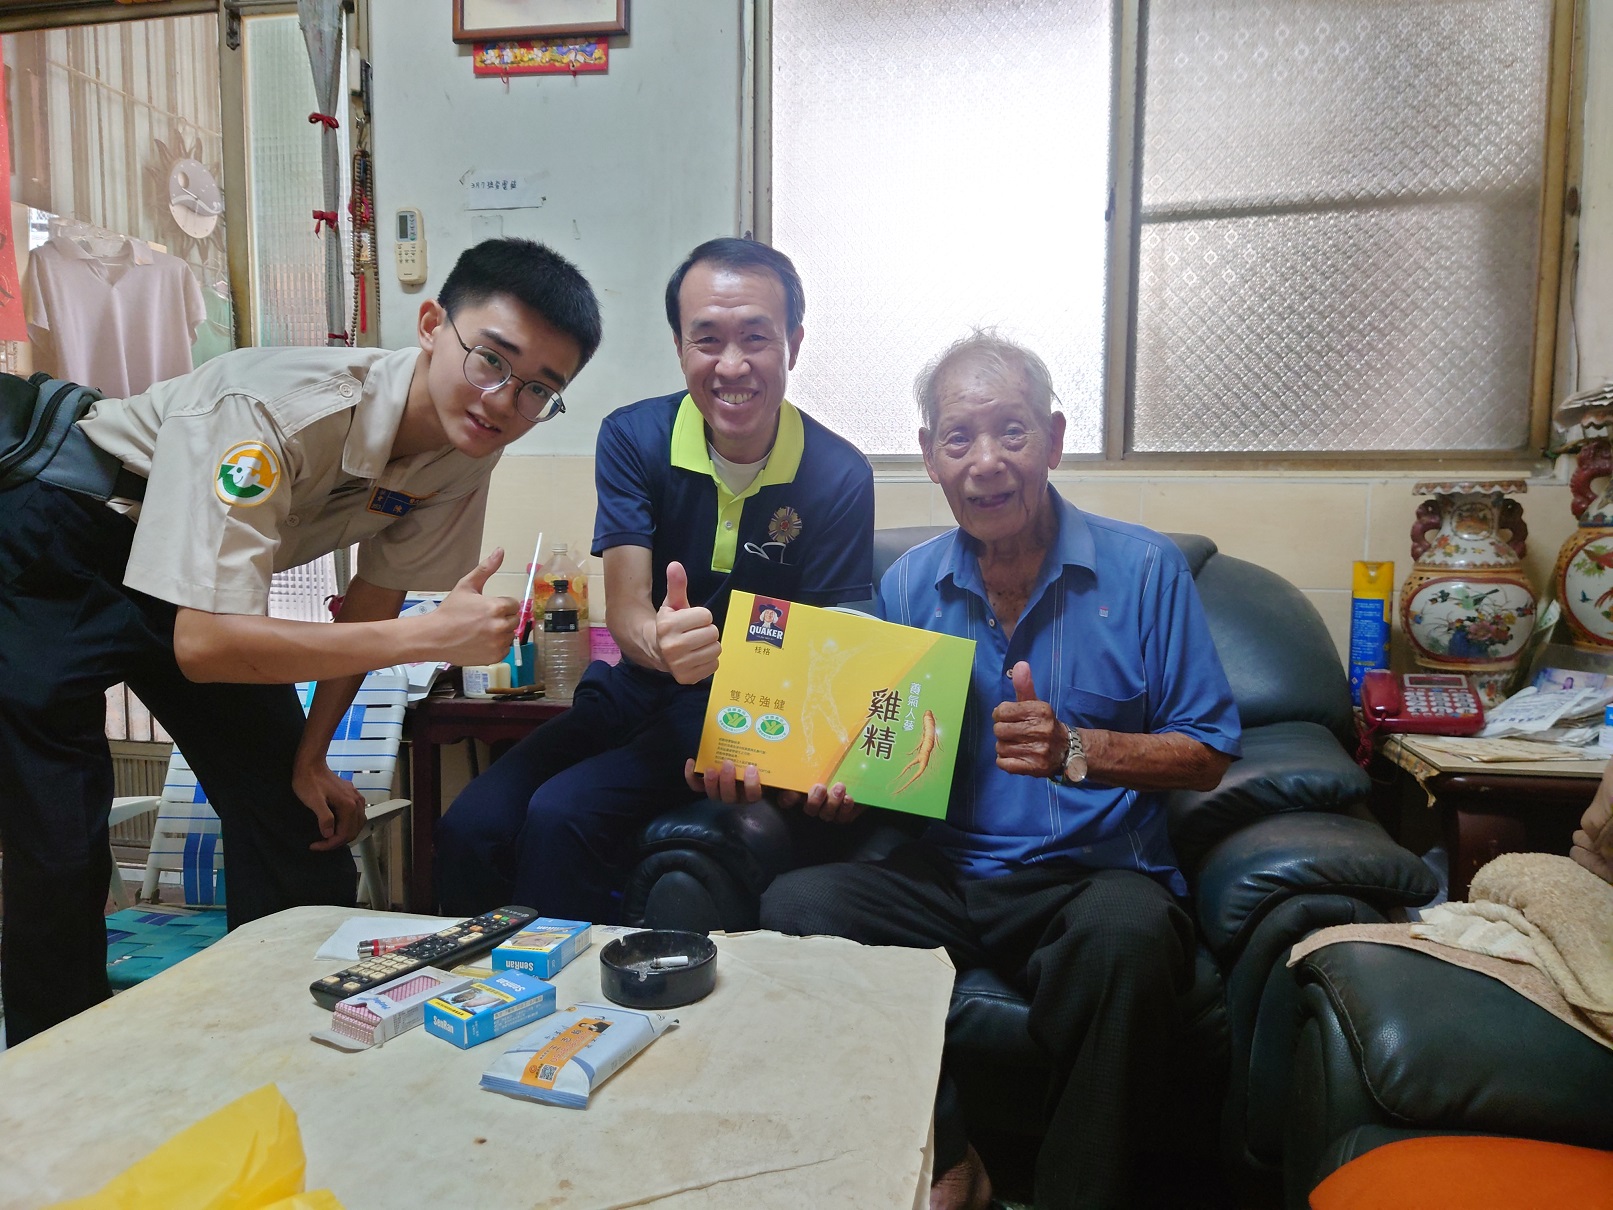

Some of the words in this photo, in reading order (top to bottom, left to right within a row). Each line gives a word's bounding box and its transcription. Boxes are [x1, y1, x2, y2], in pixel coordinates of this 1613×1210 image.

[749, 625, 784, 640] QUAKER
[754, 646, 771, 656] 桂格
[729, 689, 786, 711] 雙效強健
[859, 687, 903, 760] 雞精
[505, 960, 534, 972] SenRan
[495, 977, 526, 992] SenRan
[433, 1015, 454, 1034] SenRan
